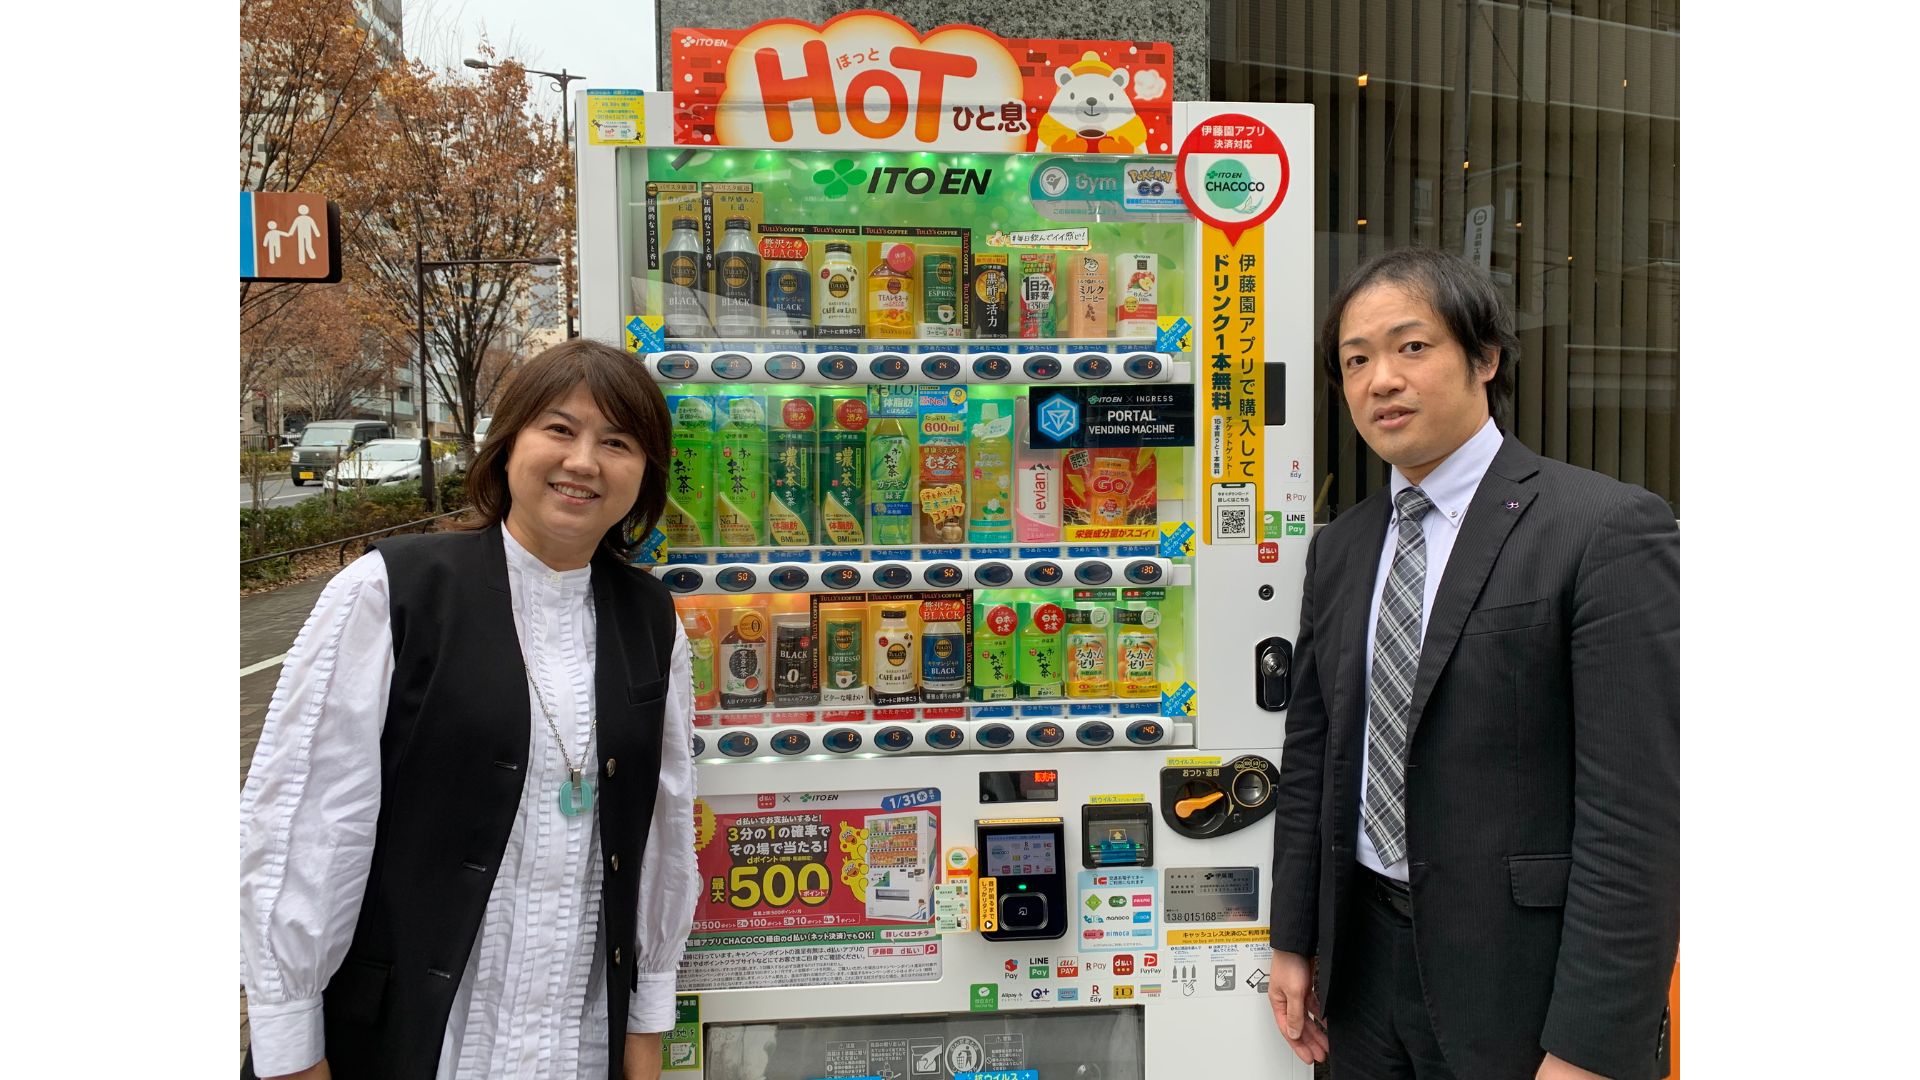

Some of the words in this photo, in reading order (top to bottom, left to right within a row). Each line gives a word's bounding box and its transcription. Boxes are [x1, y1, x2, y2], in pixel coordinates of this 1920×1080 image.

[695, 38, 713, 47] ITO
[714, 39, 728, 47] EN
[836, 48, 880, 70] ほっと
[754, 40, 978, 142] HOT
[952, 101, 1027, 133] ひと息
[1201, 126, 1265, 136] 伊藤園アプリ
[1214, 139, 1252, 149] 決済対応
[867, 167, 936, 195] ITO
[938, 168, 992, 195] EN
[1075, 173, 1117, 194] Gym
[1137, 181, 1164, 197] GO
[1206, 182, 1264, 192] CHACOCO
[764, 248, 803, 260] BLACK
[1080, 286, 1104, 294] ミルク
[1030, 292, 1049, 300] 野菜
[669, 297, 698, 306] BLACK
[722, 298, 750, 306] BLACK
[776, 303, 802, 311] BLACK
[1212, 254, 1232, 410] ドリンク1本無料
[1238, 254, 1256, 477] 伊藤園アプリで購入して
[1108, 410, 1156, 422] PORTAL
[924, 422, 960, 432] 600ml
[1088, 425, 1130, 434] VENDING
[1132, 424, 1175, 434] MACHINE
[926, 454, 958, 469] むぎ茶
[1034, 472, 1046, 510] evian
[1294, 493, 1306, 502] Pay
[932, 506, 963, 520] ゴクゴク
[1075, 528, 1155, 538] 栄養成分量がスゴイ!
[1288, 525, 1304, 534] Pay
[738, 573, 748, 581] 50
[842, 571, 853, 579] 50
[944, 568, 954, 577] 50
[924, 611, 961, 620] BLACK
[780, 651, 808, 659] BLACK
[1076, 649, 1104, 659] みかん
[1126, 650, 1153, 659] みかん
[1078, 660, 1104, 669] ゼリー
[1128, 660, 1153, 669] ゼリー
[951, 730, 956, 738] 0
[1142, 726, 1155, 734] 140
[744, 737, 750, 745] 0
[736, 814, 822, 826] d払いでお支払いすると!
[728, 824, 830, 842] 3分の1の確率で
[730, 841, 828, 856] その場で当たる!
[711, 878, 725, 903] 最大
[730, 863, 831, 908] 500
[1184, 912, 1217, 921] 015168
[1116, 987, 1132, 996] iD
